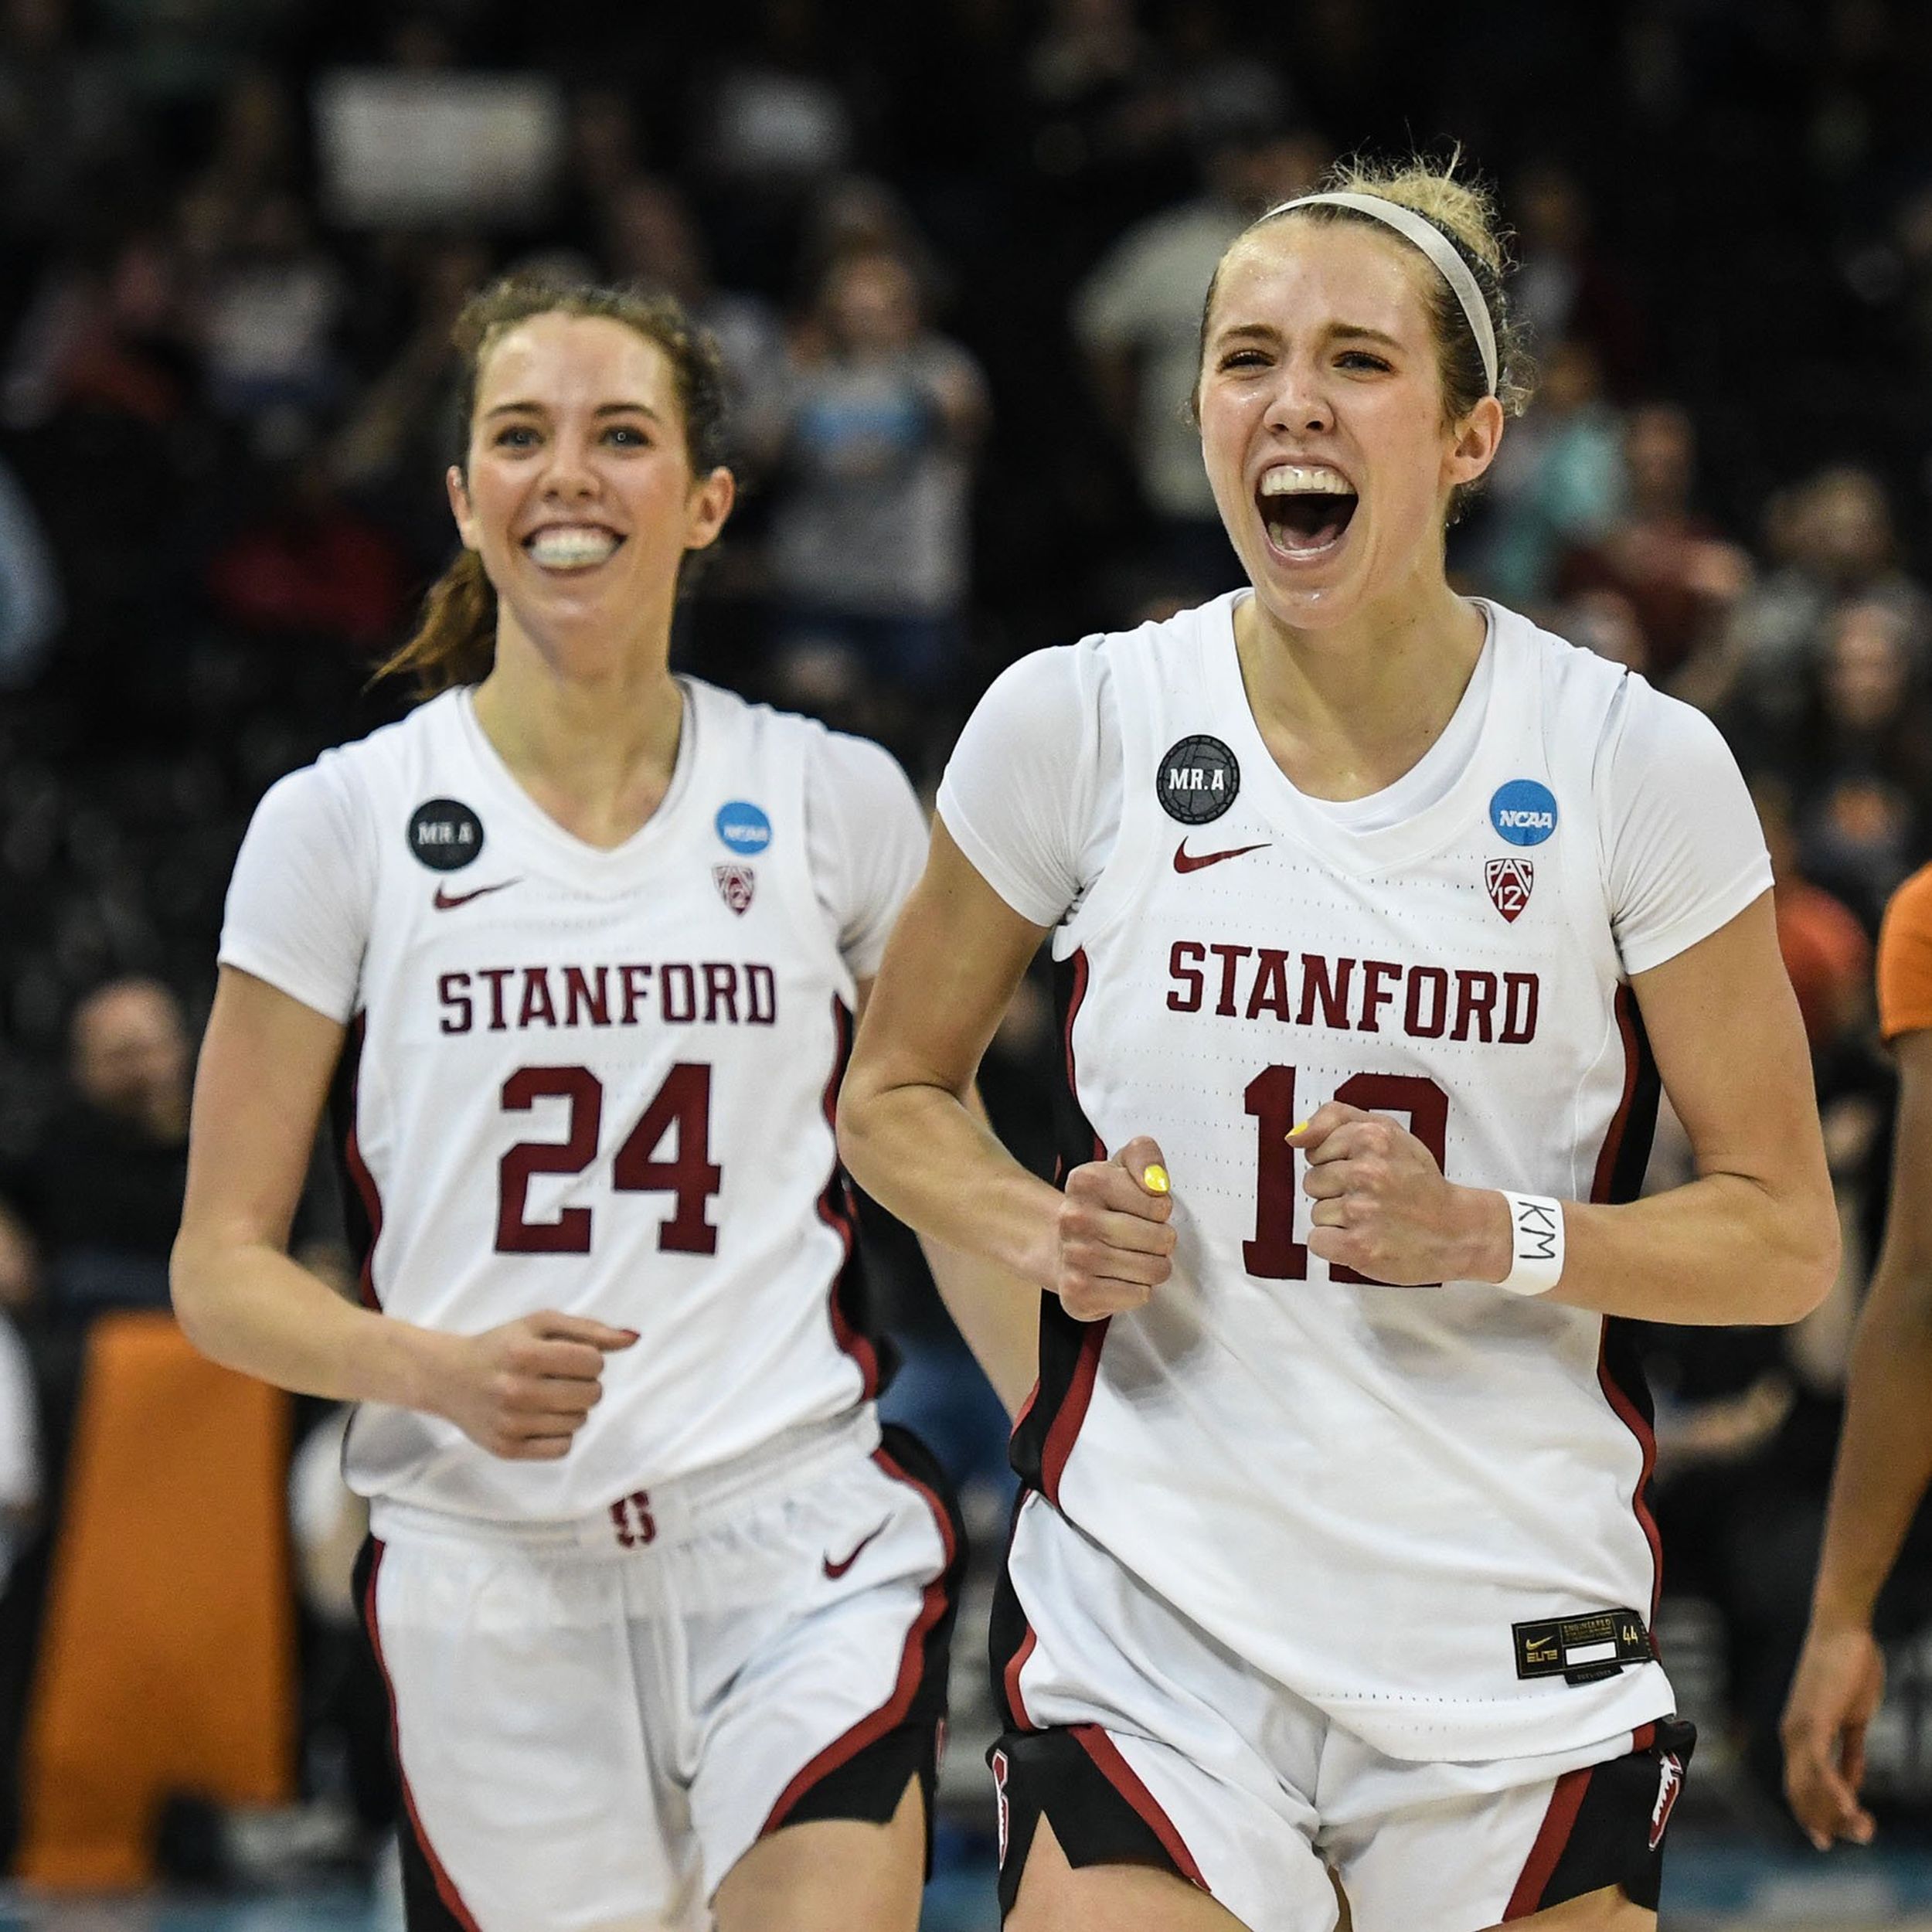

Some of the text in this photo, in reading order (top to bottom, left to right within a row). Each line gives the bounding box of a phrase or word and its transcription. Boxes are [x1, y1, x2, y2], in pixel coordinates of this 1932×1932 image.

[1499, 811, 1553, 829] NCAA
[1486, 859, 1533, 897] PAC
[1497, 885, 1522, 911] 12
[438, 964, 775, 1034] STANFORD
[1166, 940, 1539, 1045] STANFORD
[495, 1063, 722, 1255] 24
[1517, 1200, 1556, 1260] KM
[1622, 1624, 1639, 1646] 44
